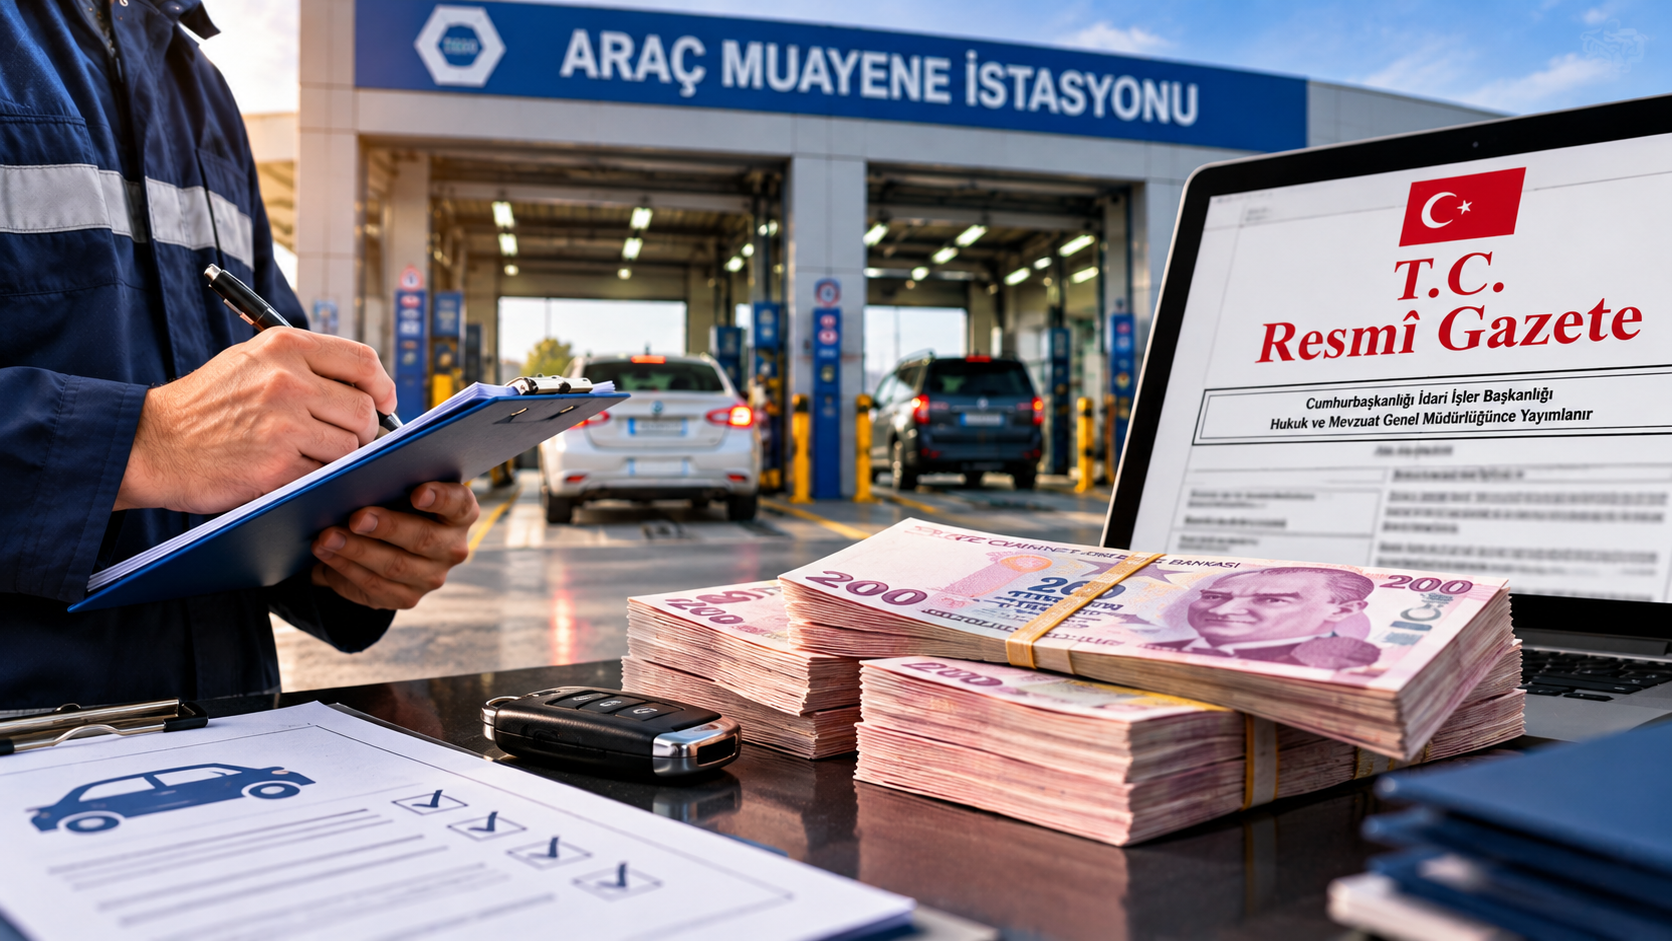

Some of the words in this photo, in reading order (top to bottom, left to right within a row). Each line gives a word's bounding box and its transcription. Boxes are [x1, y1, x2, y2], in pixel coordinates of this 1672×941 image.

[559, 28, 707, 98] ARAÇ
[721, 38, 951, 104] MUAYENE
[965, 49, 1199, 127] İSTASYONU
[1394, 251, 1505, 301] T.C.
[1255, 309, 1421, 364] Resmî
[1437, 297, 1643, 352] Gazete
[1418, 390, 1448, 405] İdari
[1451, 389, 1480, 406] İşler
[1270, 417, 1308, 430] Hukuk
[1312, 419, 1326, 429] ve
[1328, 415, 1380, 428] Mevzuat
[1383, 412, 1420, 427] Genel
[1521, 407, 1593, 425] Yayımlanır
[805, 570, 928, 606] 200
[1379, 574, 1474, 595] 200
